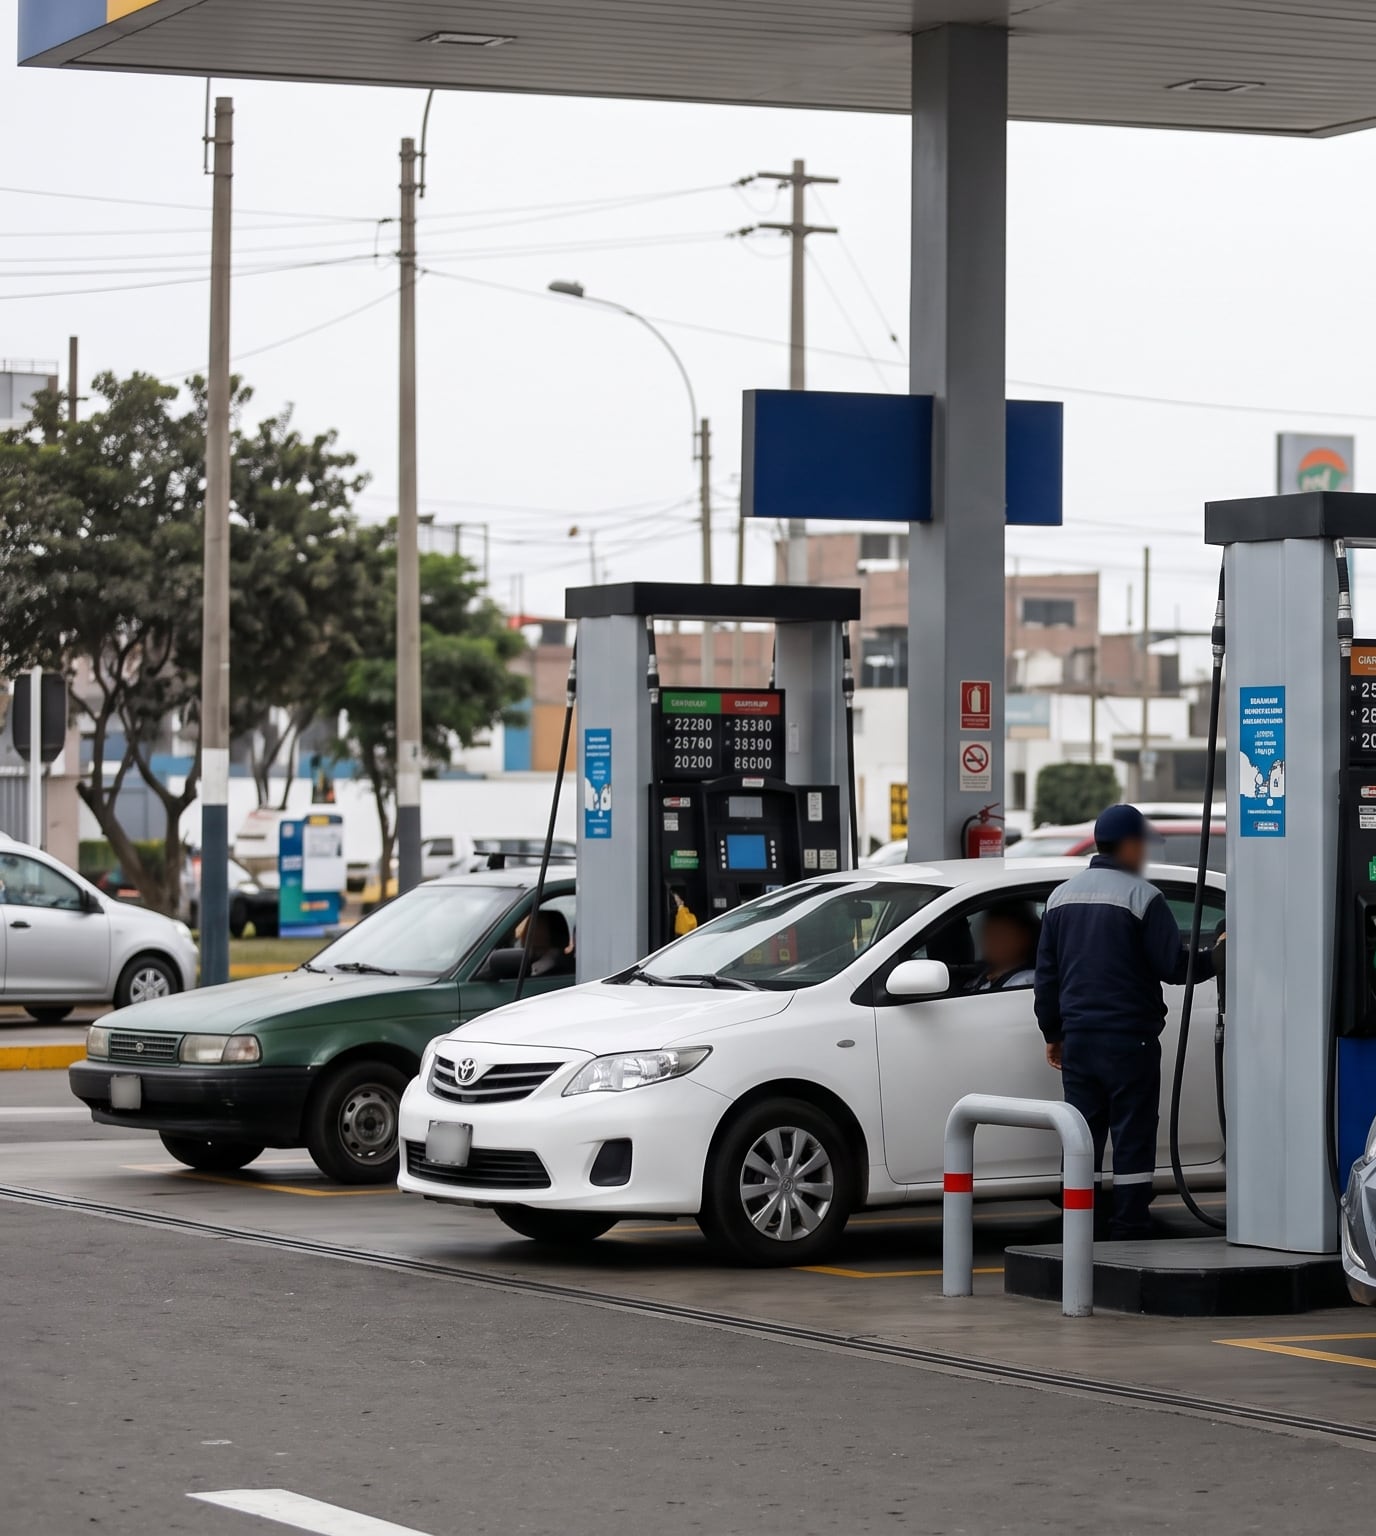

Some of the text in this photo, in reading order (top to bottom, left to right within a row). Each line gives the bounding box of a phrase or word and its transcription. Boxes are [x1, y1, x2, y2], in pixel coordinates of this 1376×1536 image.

[734, 719, 772, 732] 35380
[734, 738, 772, 751] 38390
[674, 755, 712, 769] 20200
